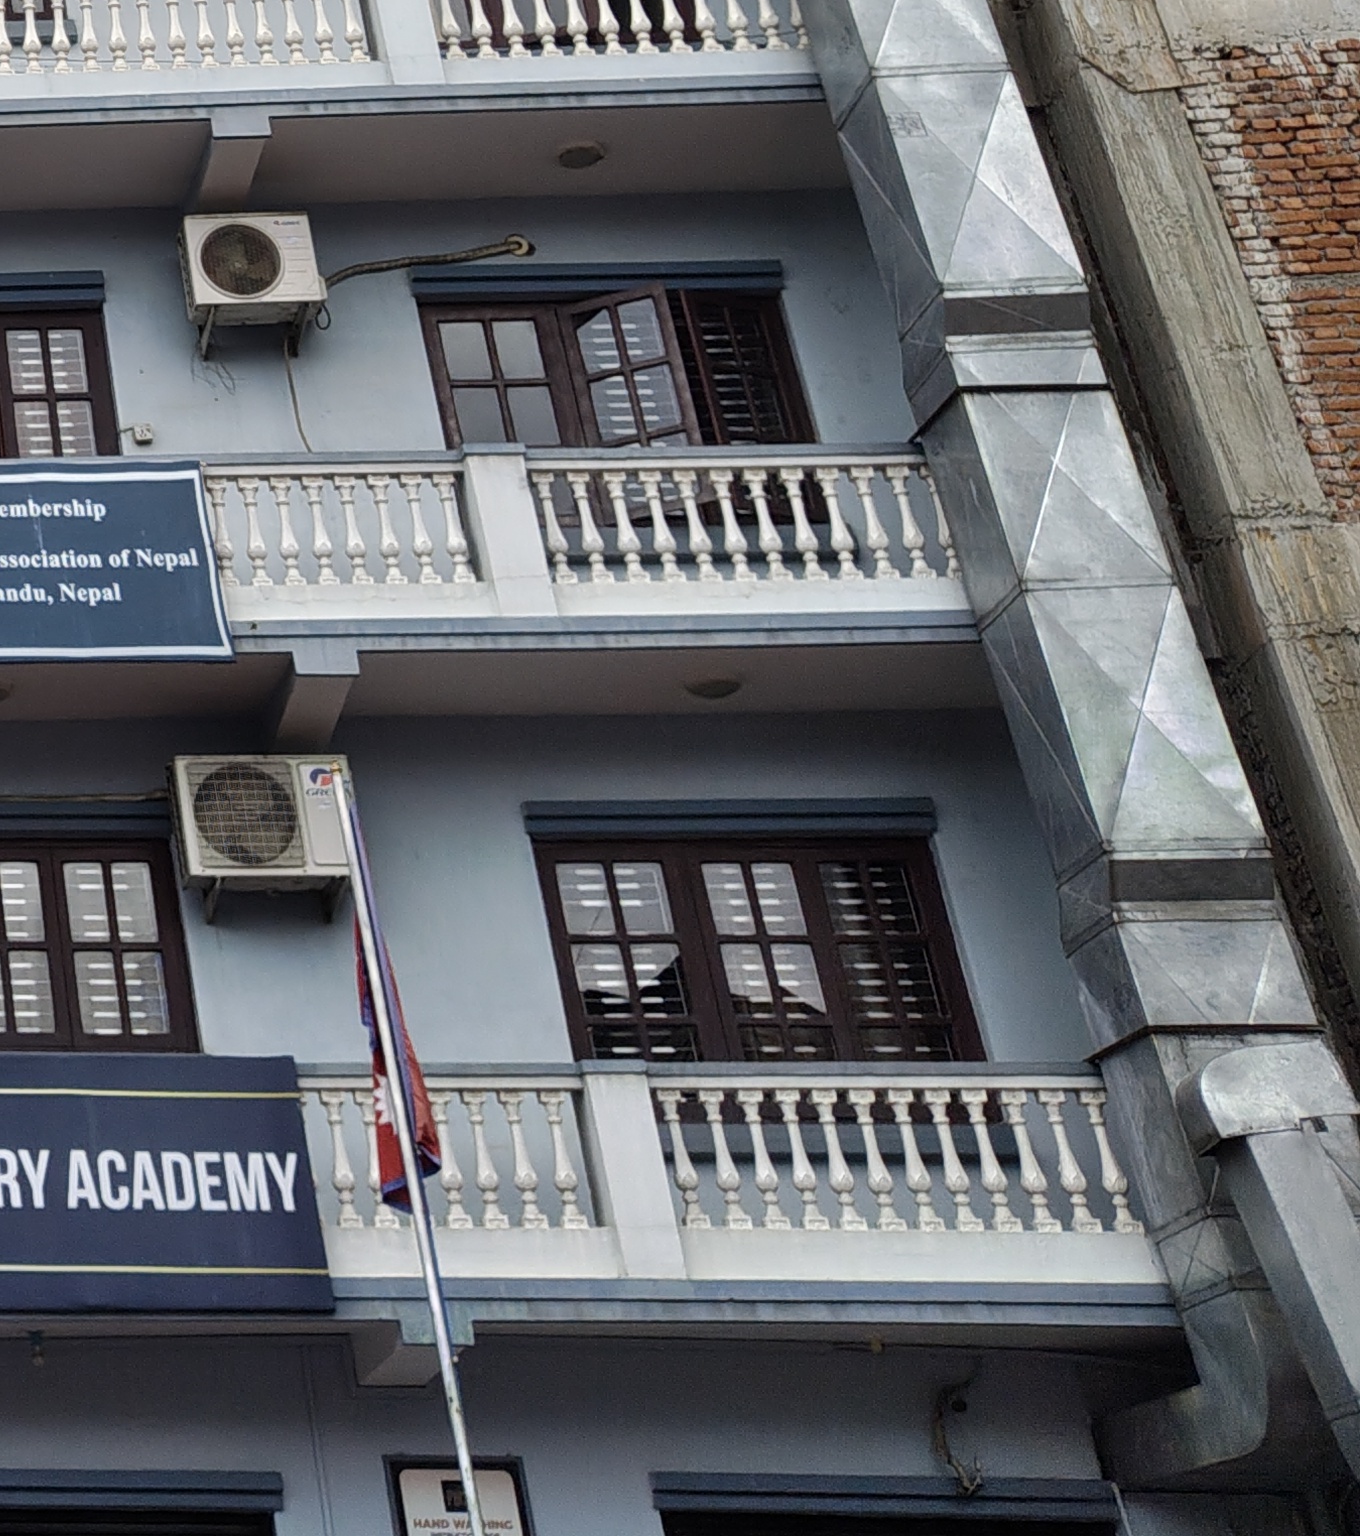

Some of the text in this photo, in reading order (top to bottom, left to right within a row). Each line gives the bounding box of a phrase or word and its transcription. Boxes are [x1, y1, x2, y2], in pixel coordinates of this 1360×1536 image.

[108, 549, 131, 568] of
[133, 547, 200, 572] Nepal
[58, 582, 122, 606] Nepal
[67, 1148, 298, 1213] ACADEMY
[413, 1518, 450, 1529] HAND
